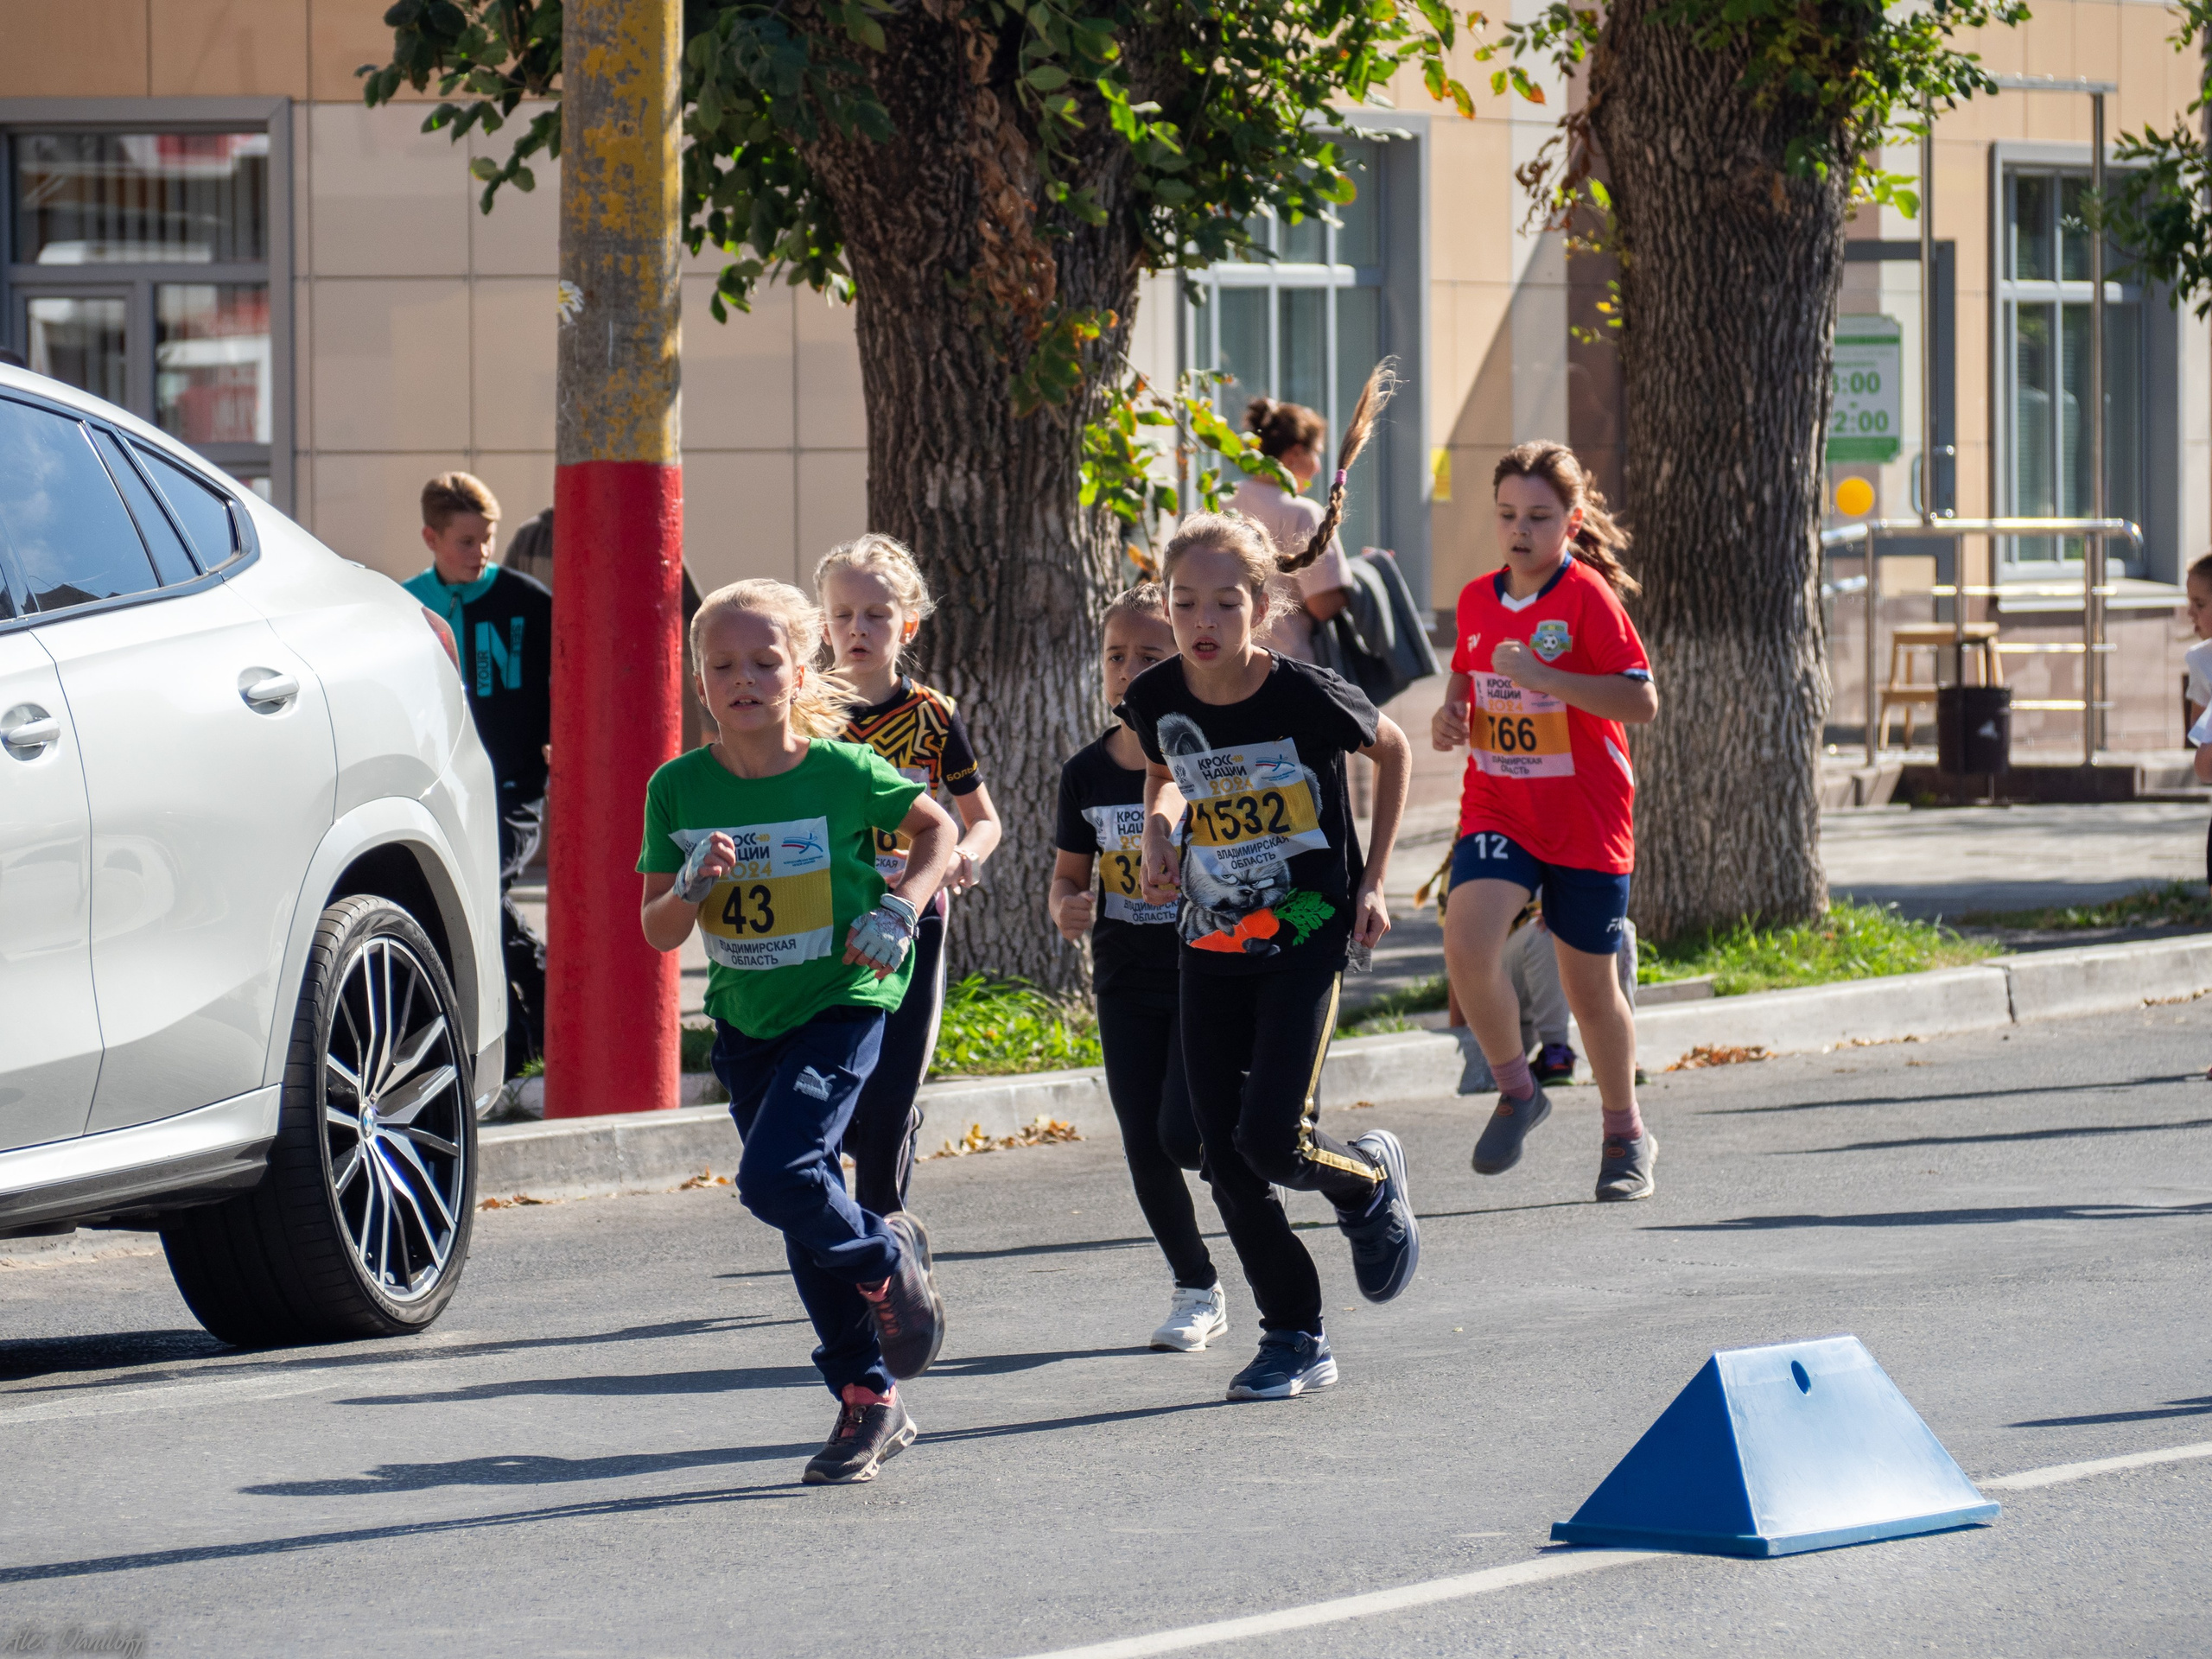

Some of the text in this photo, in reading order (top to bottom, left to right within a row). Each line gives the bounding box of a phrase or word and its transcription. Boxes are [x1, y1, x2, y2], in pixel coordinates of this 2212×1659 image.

[1829, 410, 1890, 433] 2:00
[478, 651, 490, 690] YOUR
[1486, 678, 1513, 690] КРОСС
[1487, 688, 1521, 701] НАЦИИ
[1488, 700, 1523, 712] 2024
[1198, 754, 1233, 771] КРОСС
[1202, 764, 1248, 781] НАЦИИ
[1210, 778, 1254, 795] 2024
[1116, 810, 1146, 823] КРО
[1197, 791, 1291, 842] 1532
[1217, 835, 1290, 861] ВЛАДИМИРСКАЯ
[1475, 834, 1509, 860] 12
[1230, 851, 1276, 870] ОБЛАСТЬ
[720, 861, 772, 880] 024
[721, 884, 775, 934] 43
[1132, 911, 1176, 922] ОБЛАСТЬ
[731, 955, 779, 966] ОБЛАСТЬ
